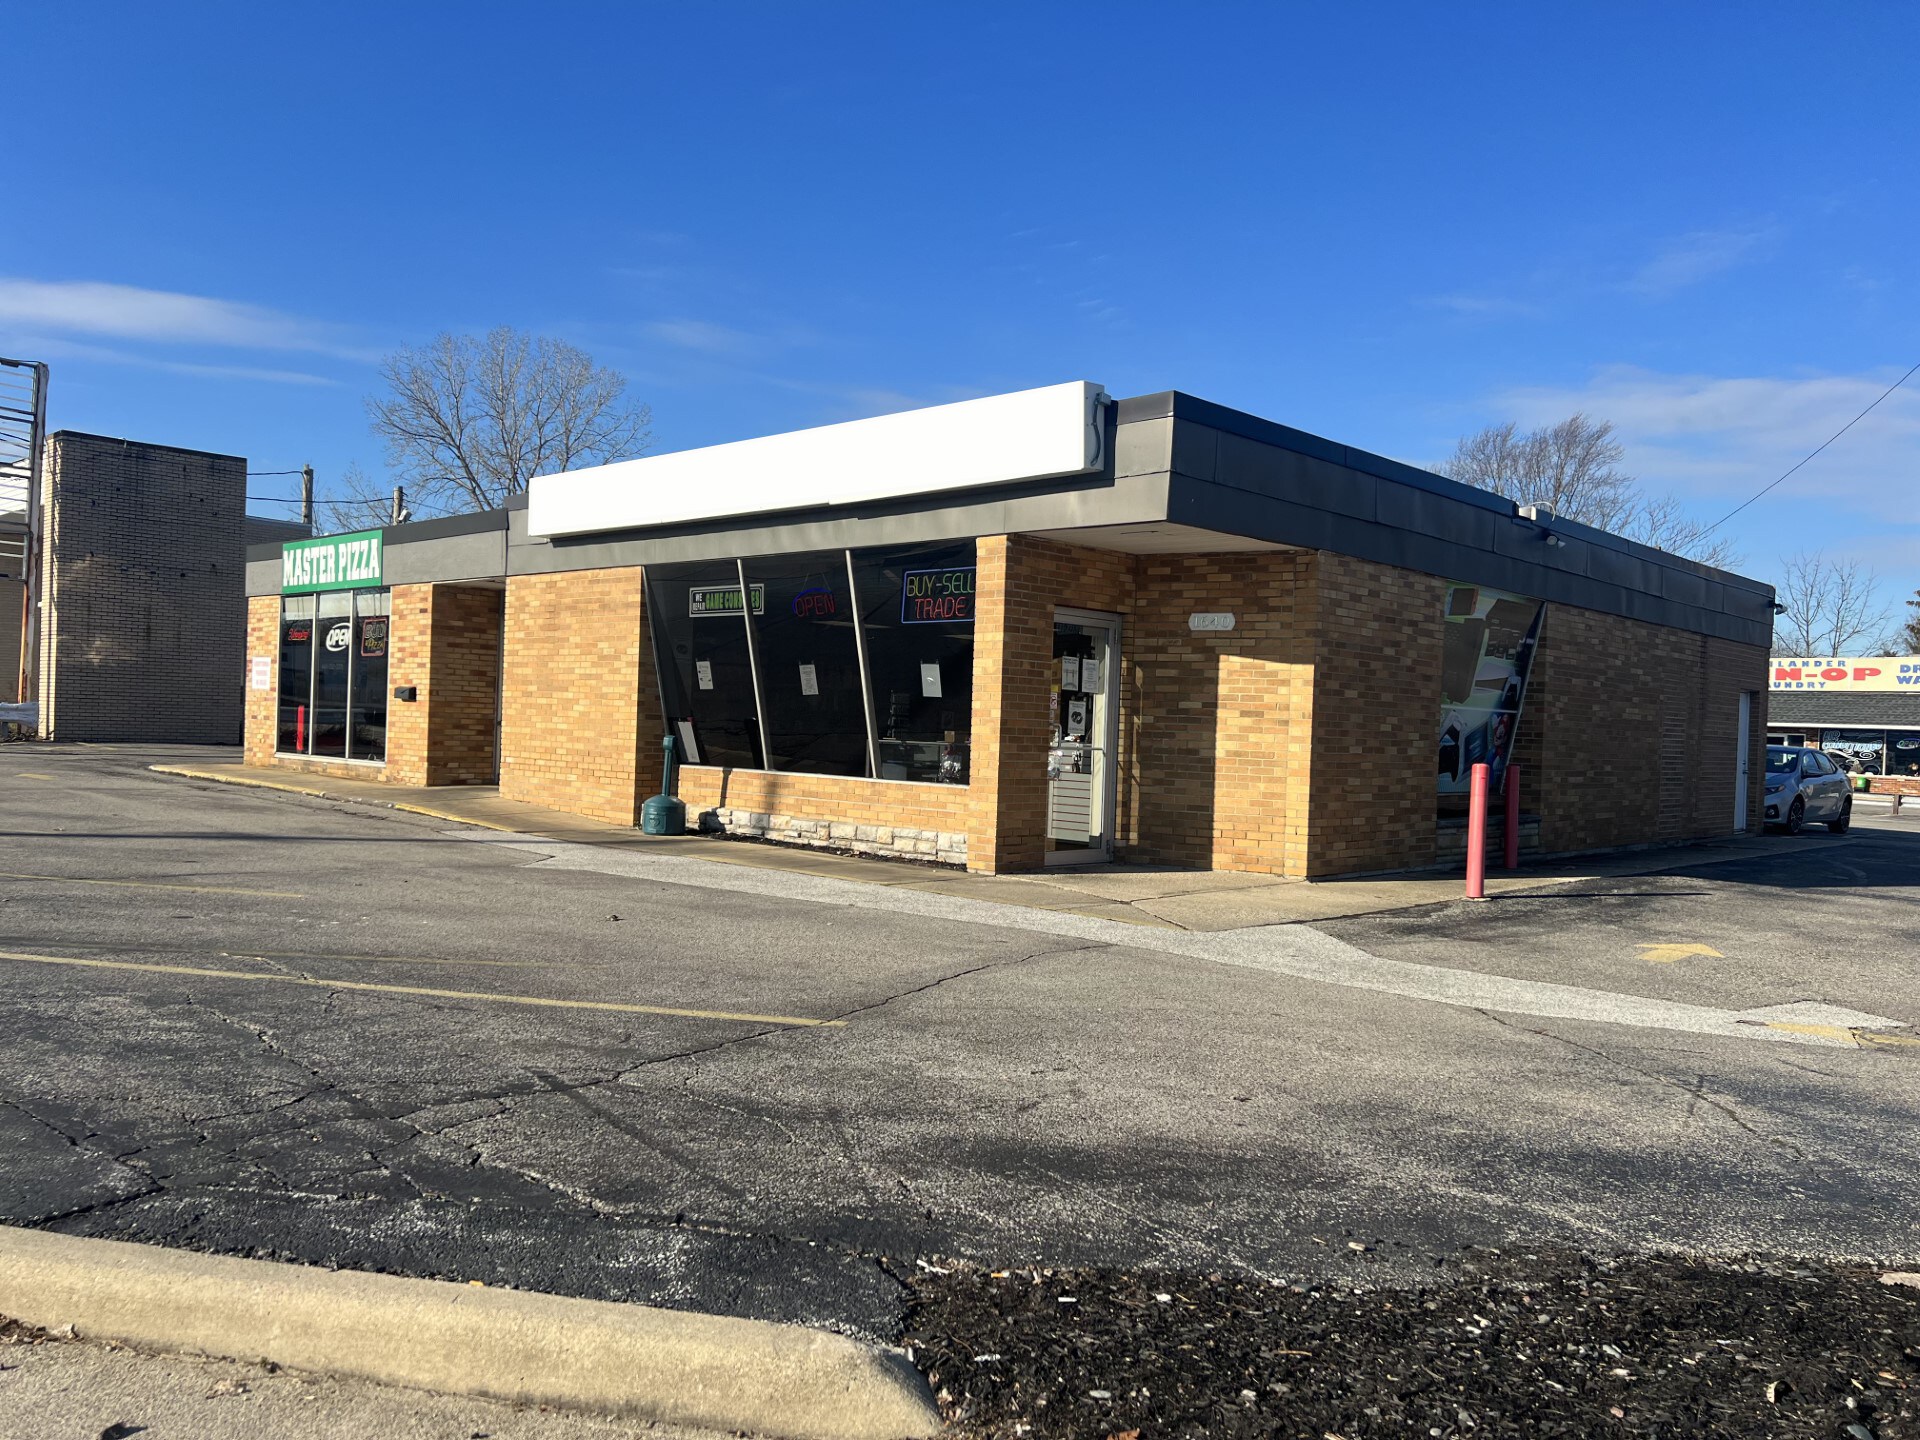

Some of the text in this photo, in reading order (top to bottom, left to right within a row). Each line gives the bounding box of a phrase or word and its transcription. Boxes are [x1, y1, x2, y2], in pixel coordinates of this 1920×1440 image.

[283, 538, 380, 587] MASTER PIZZA
[906, 572, 976, 597] BUY-SELL
[705, 590, 760, 610] GAME CONSES
[795, 594, 836, 617] OPEN
[915, 597, 967, 619] TRADE
[1769, 667, 1882, 681] N-OP
[1769, 681, 1826, 689] UNDRY
